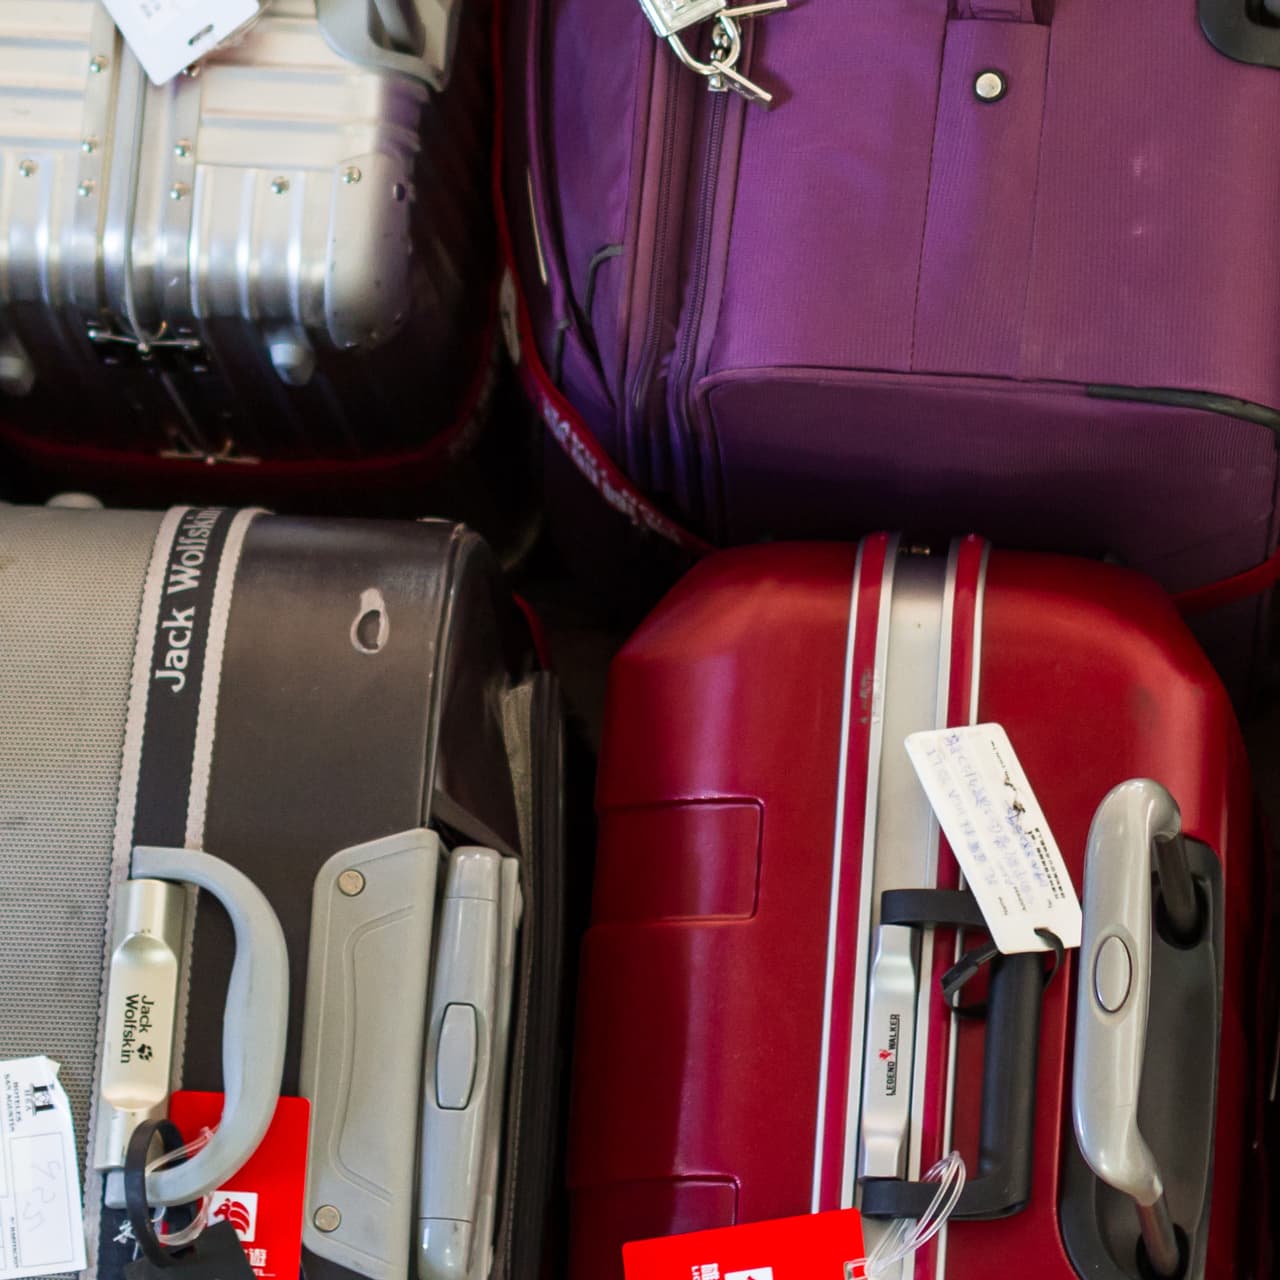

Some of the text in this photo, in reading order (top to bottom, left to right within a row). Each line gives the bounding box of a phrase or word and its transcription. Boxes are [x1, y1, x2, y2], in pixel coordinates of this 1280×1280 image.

[154, 506, 224, 693] Jack Wolfskin
[120, 993, 140, 1064] Wolfskin
[139, 994, 155, 1034] Jack
[886, 1013, 900, 1096] LEGEND WALKER
